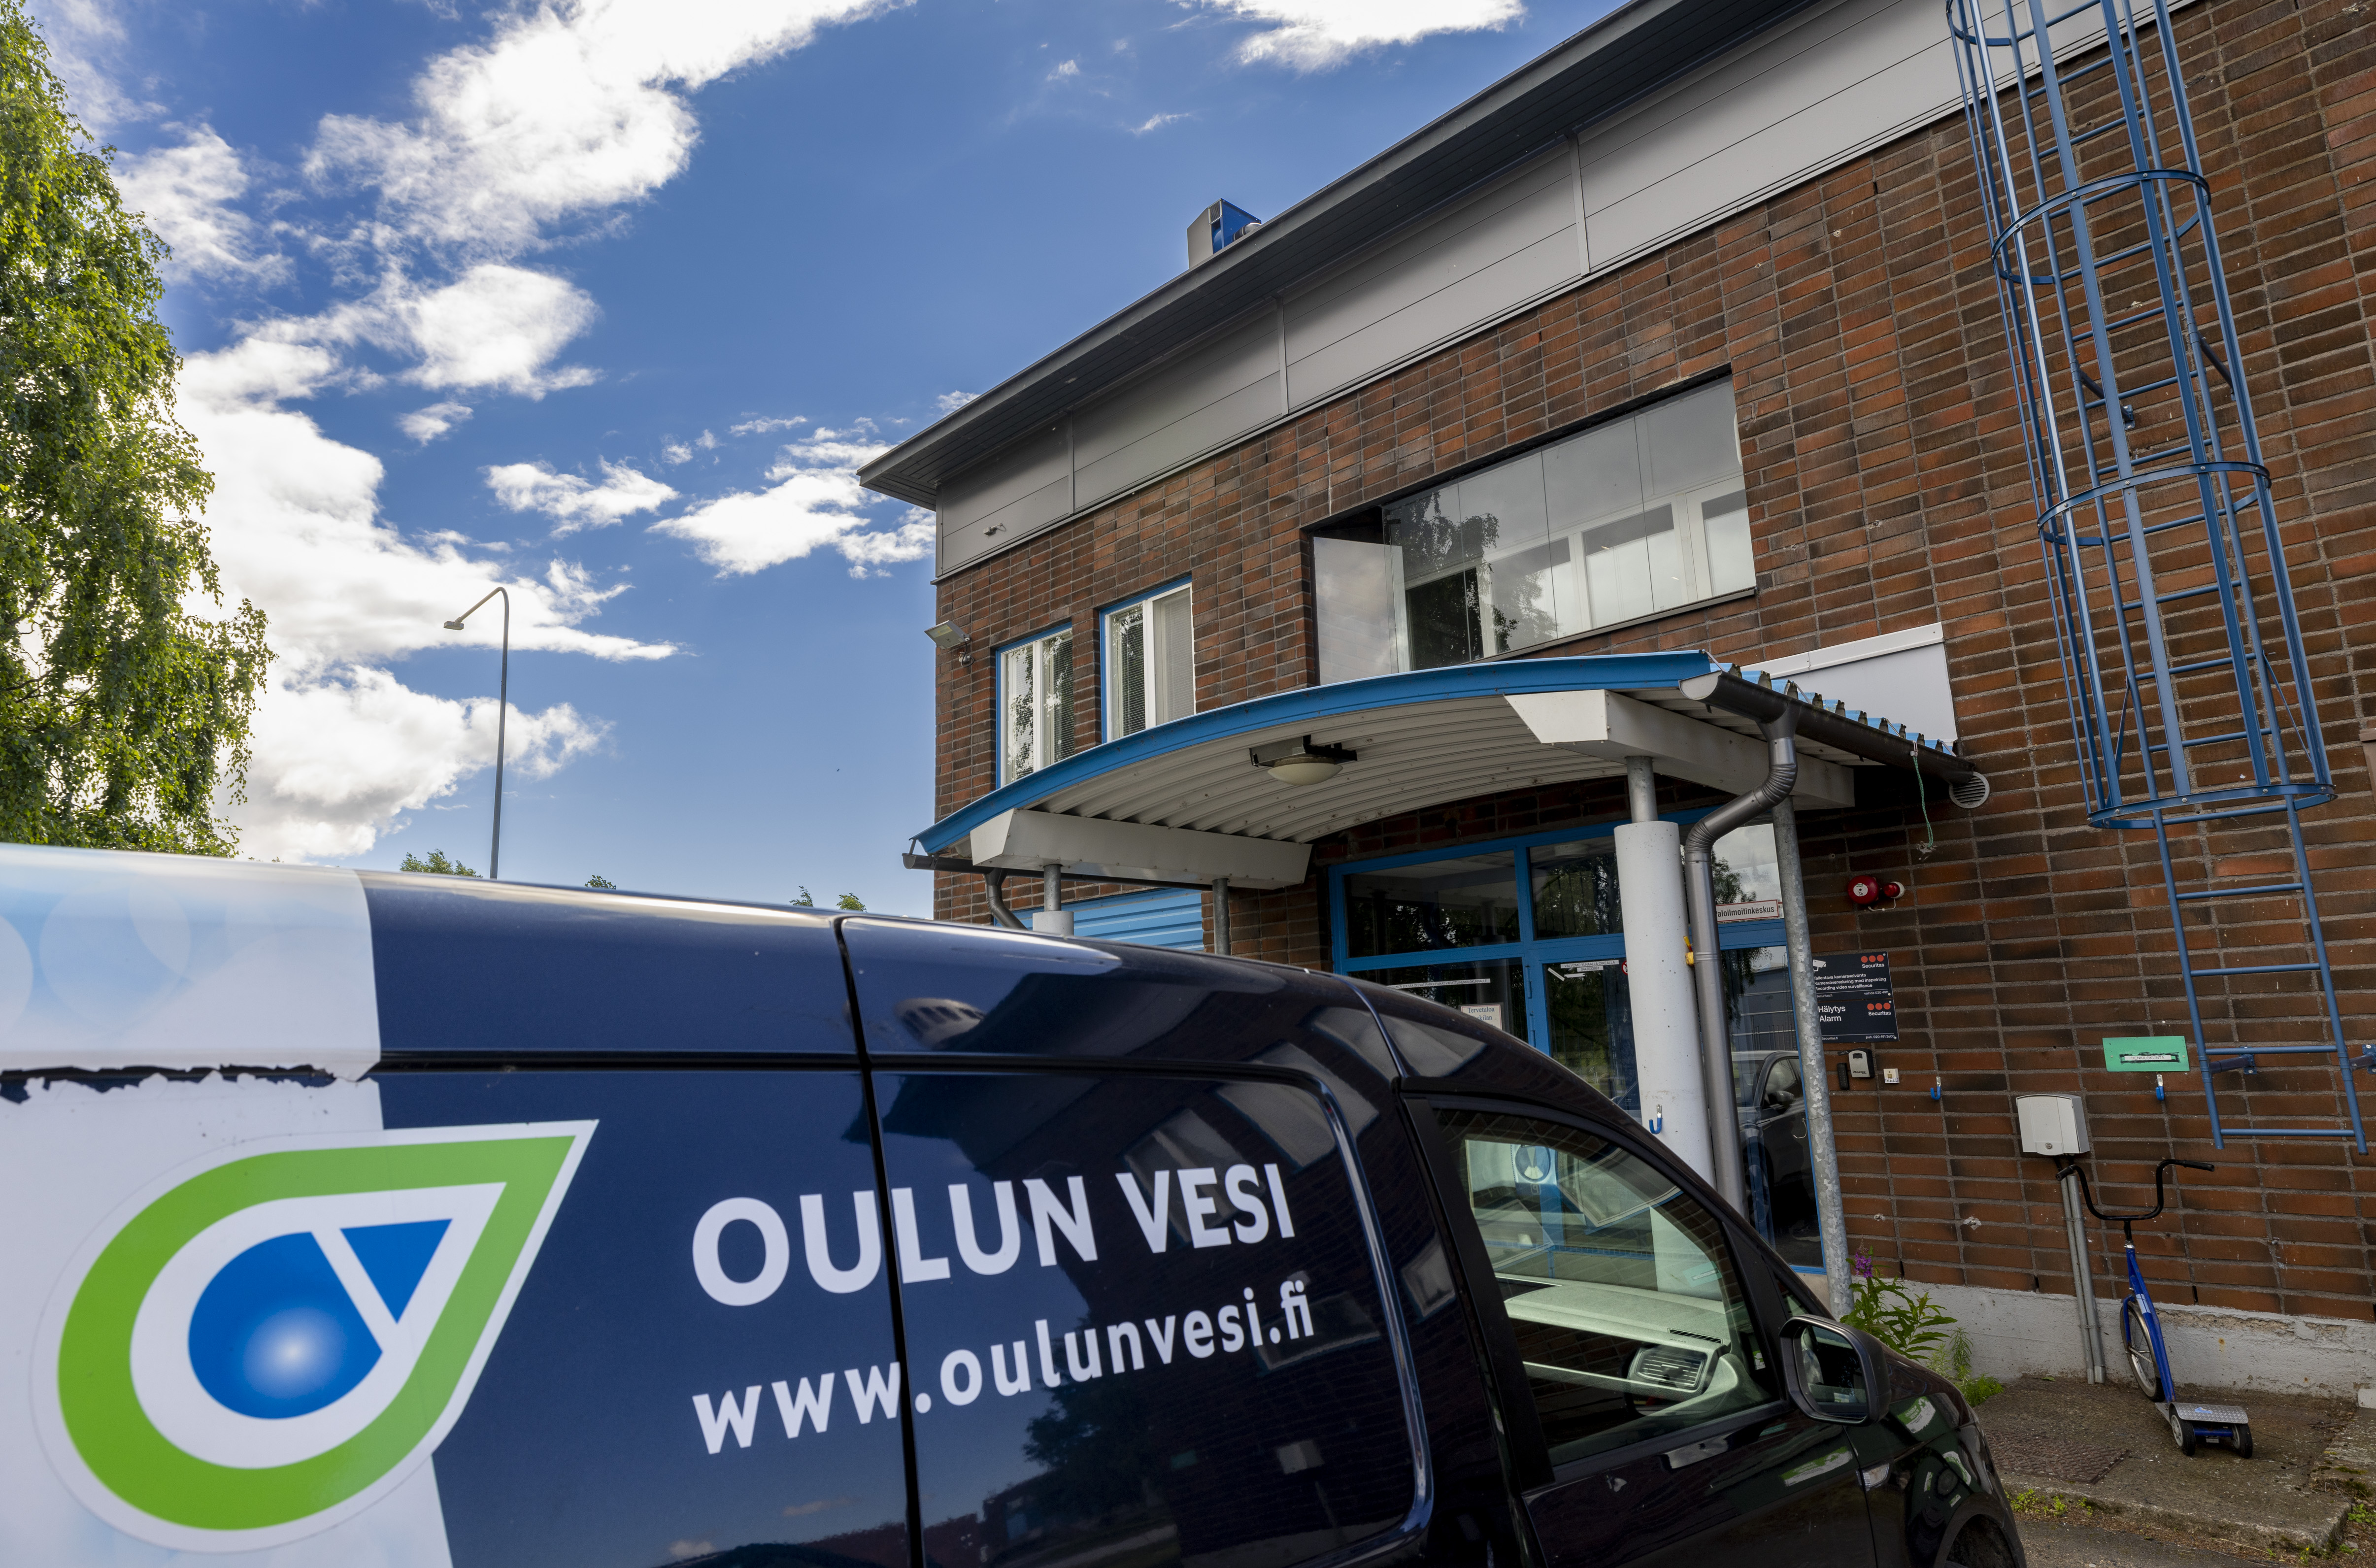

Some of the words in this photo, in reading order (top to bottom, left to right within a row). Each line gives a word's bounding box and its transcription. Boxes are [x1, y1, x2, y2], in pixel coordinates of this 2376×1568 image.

[1716, 906, 1774, 917] aloilmoitinkeskus
[692, 1176, 1098, 1306] OULUN
[1115, 1163, 1295, 1254] VESI
[692, 1280, 1315, 1454] www.oulunvesi.fi
